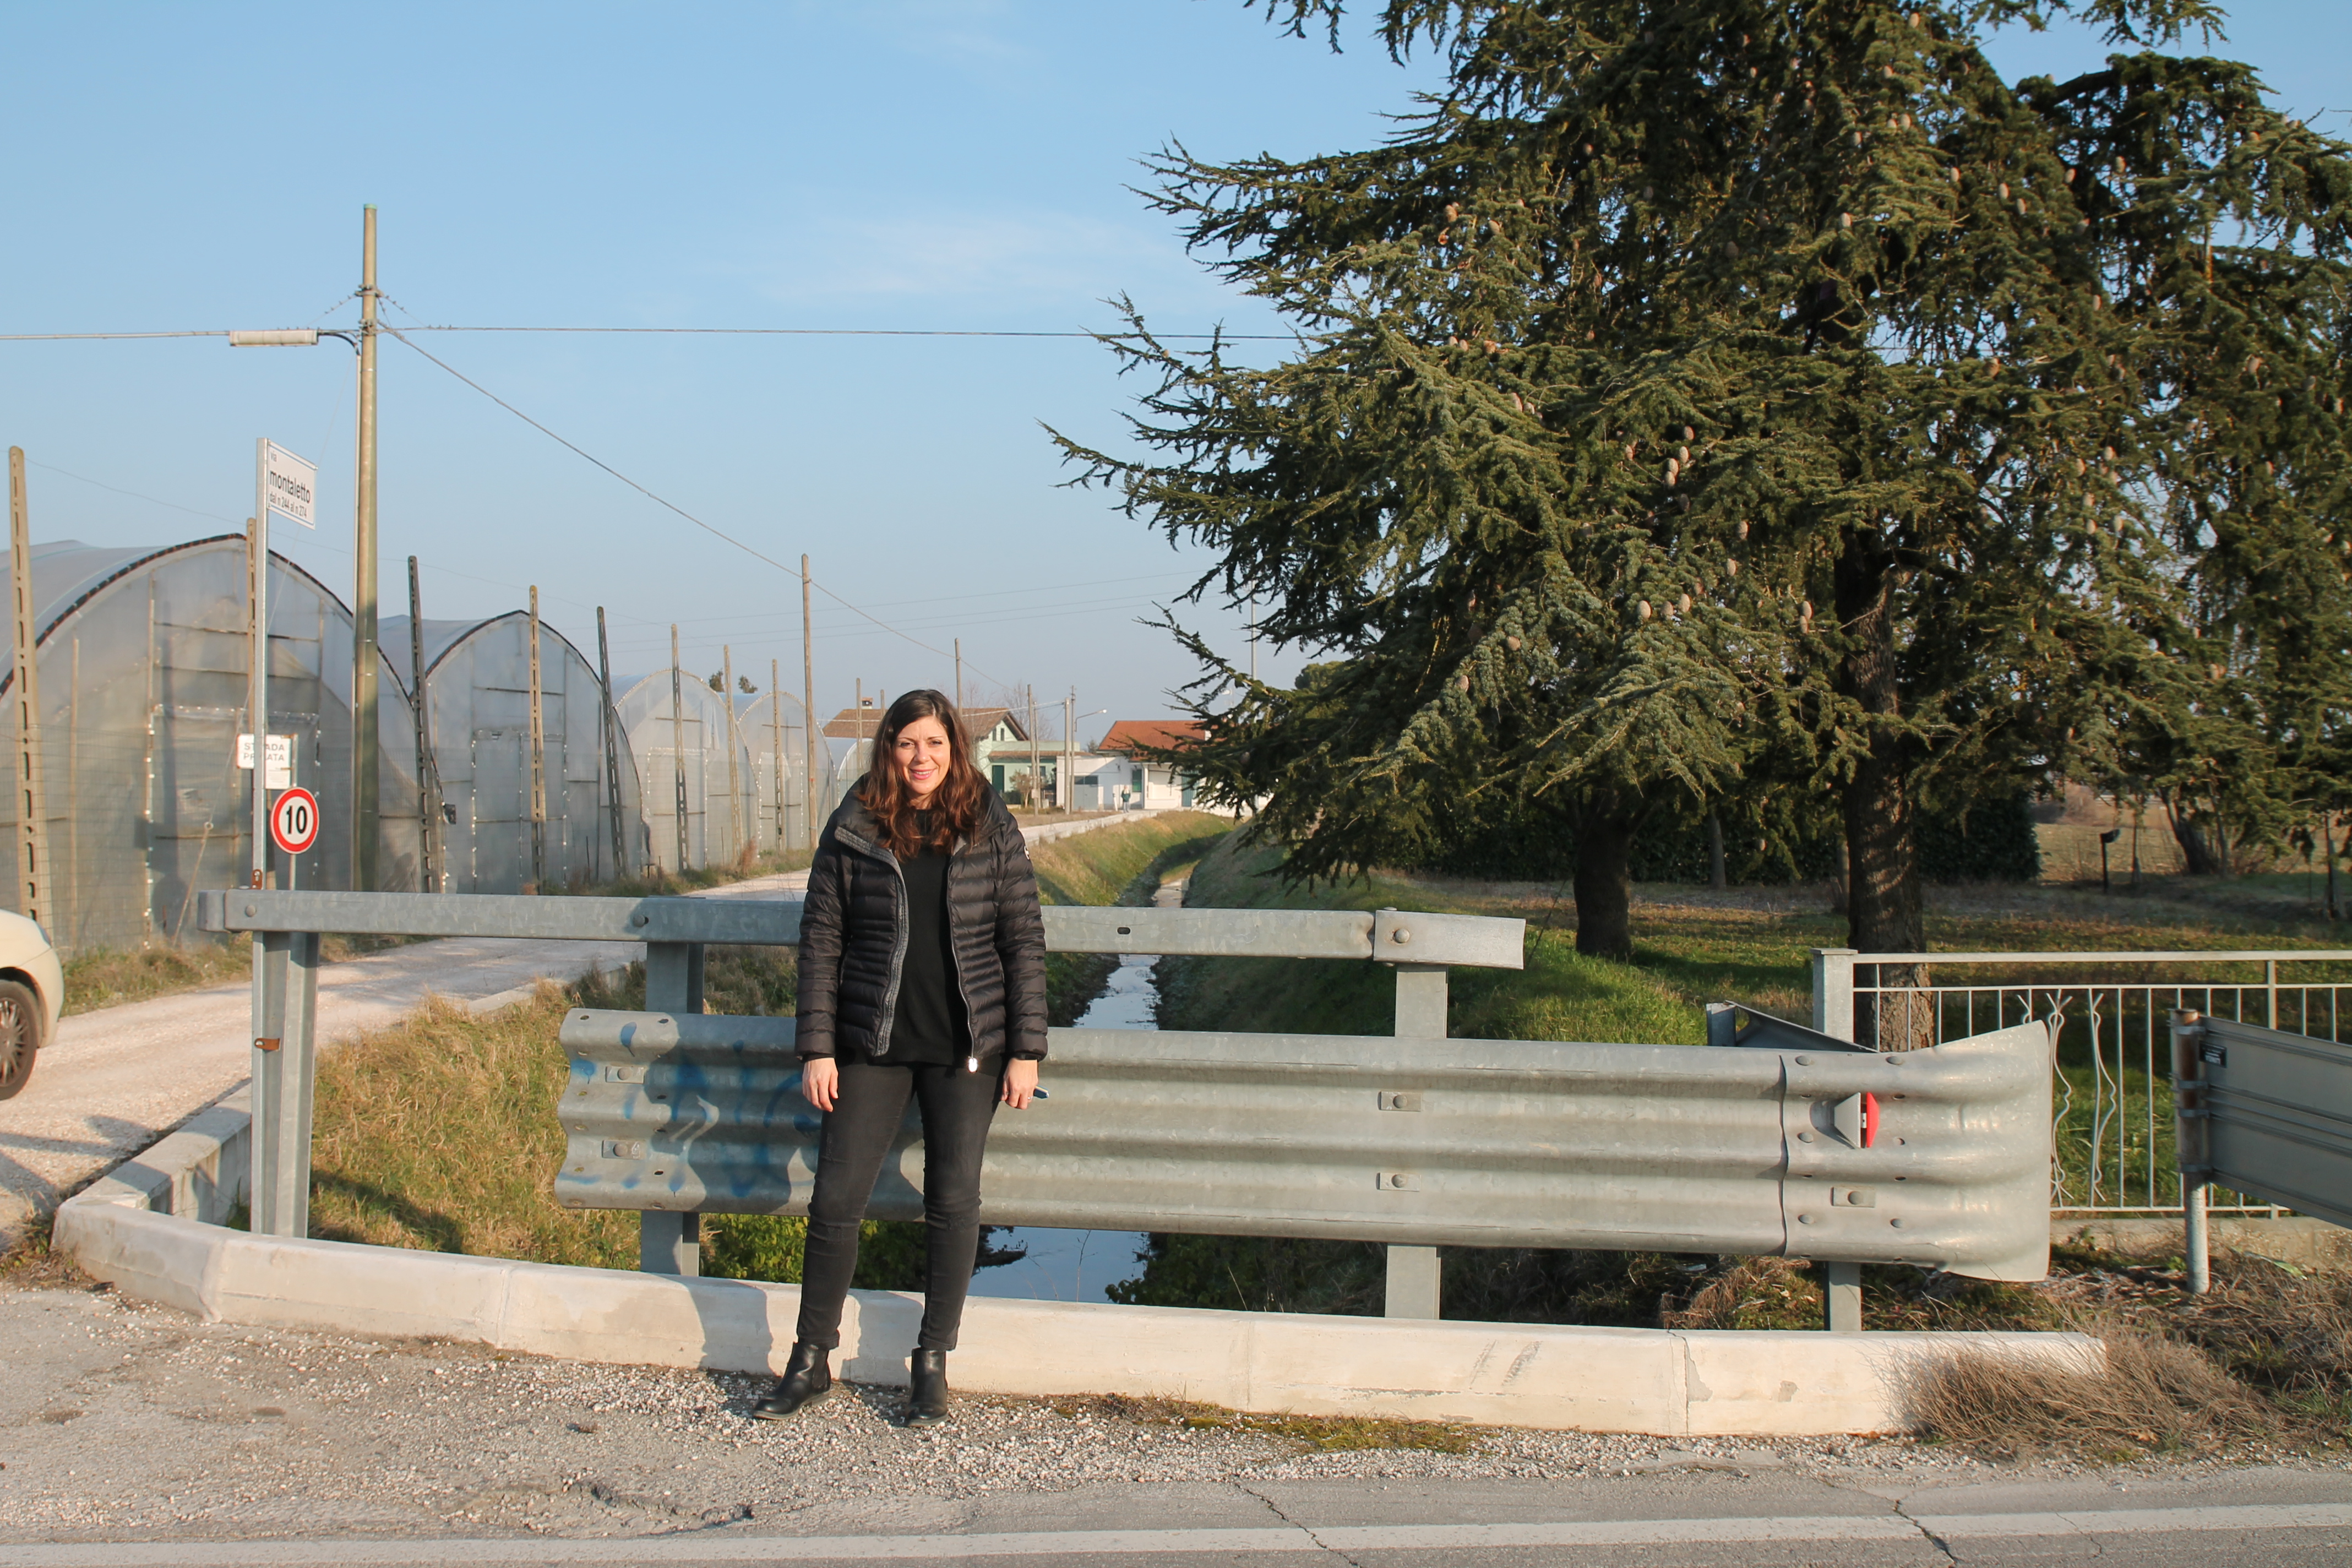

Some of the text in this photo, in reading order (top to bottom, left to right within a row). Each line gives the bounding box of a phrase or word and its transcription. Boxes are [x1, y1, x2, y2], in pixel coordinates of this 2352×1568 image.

[270, 470, 311, 504] montaletto
[281, 496, 290, 510] 244
[290, 502, 295, 513] al
[299, 505, 307, 519] 274
[286, 805, 308, 834] 10
